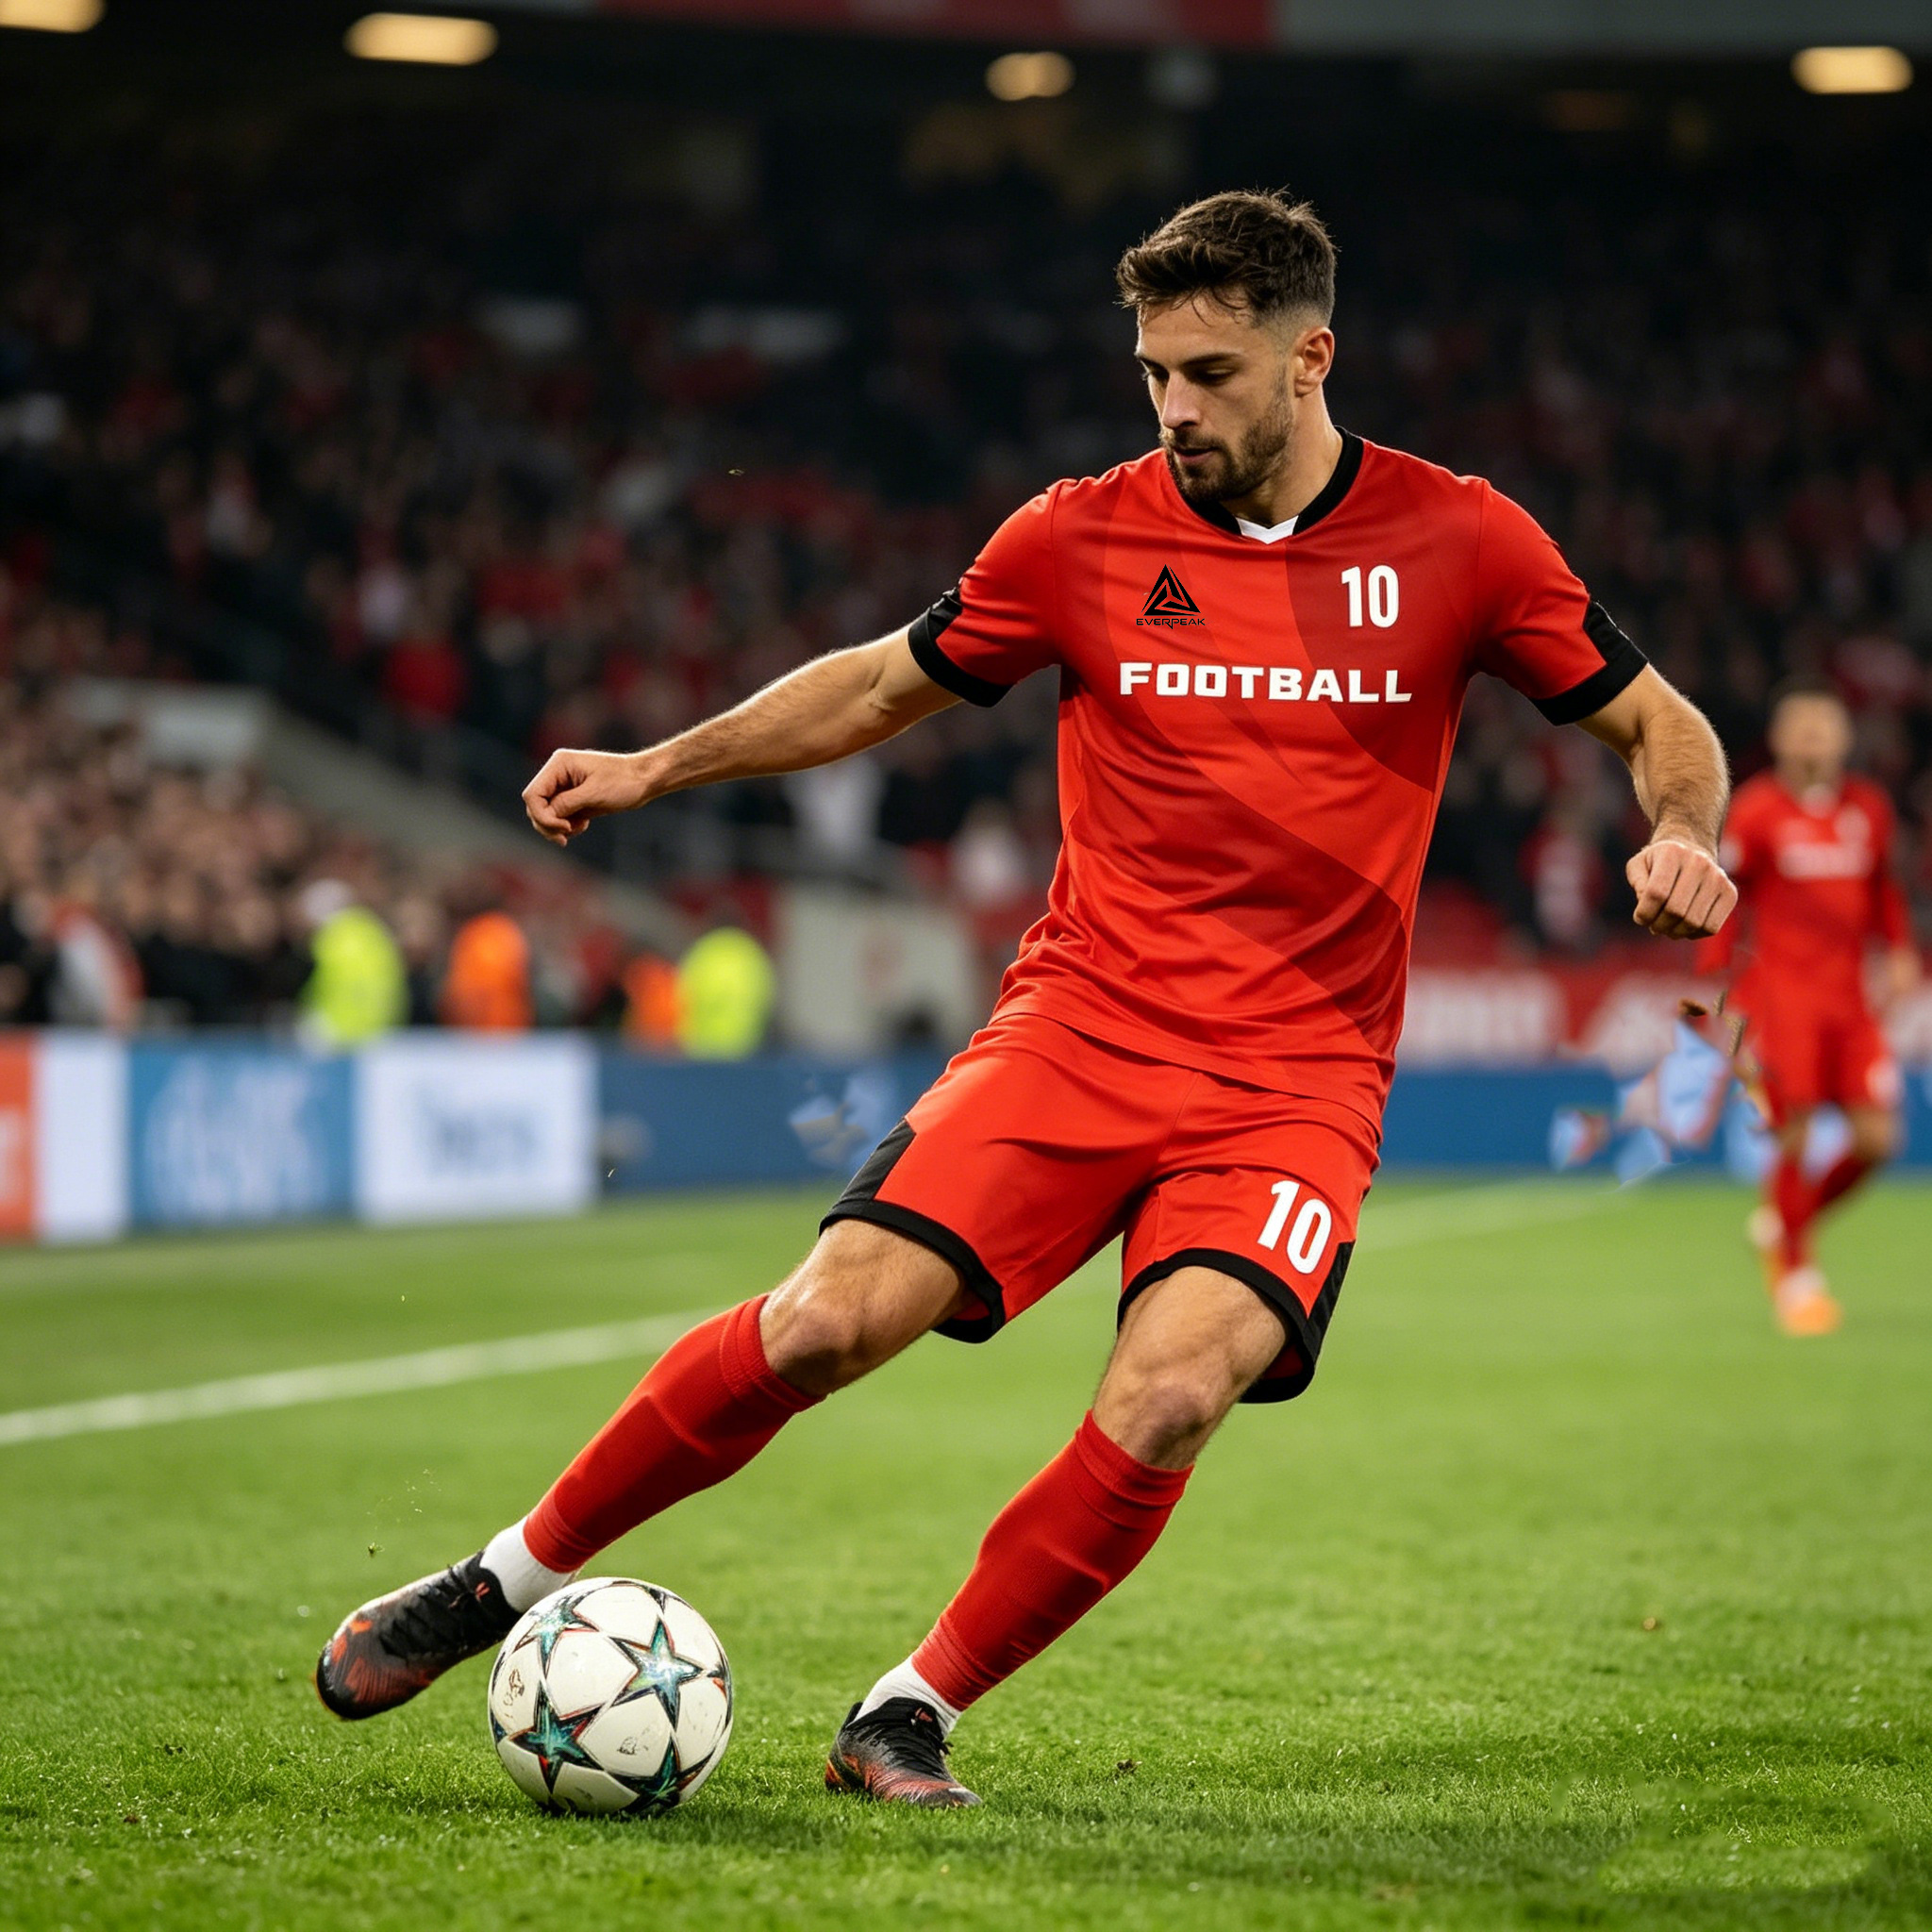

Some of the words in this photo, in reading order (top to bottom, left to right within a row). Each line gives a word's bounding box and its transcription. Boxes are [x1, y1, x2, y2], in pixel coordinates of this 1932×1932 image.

[1341, 565, 1399, 628] 10
[1136, 618, 1206, 630] EVERPEAK
[1120, 662, 1412, 703] FOOTBALL
[1257, 1179, 1332, 1274] 10
